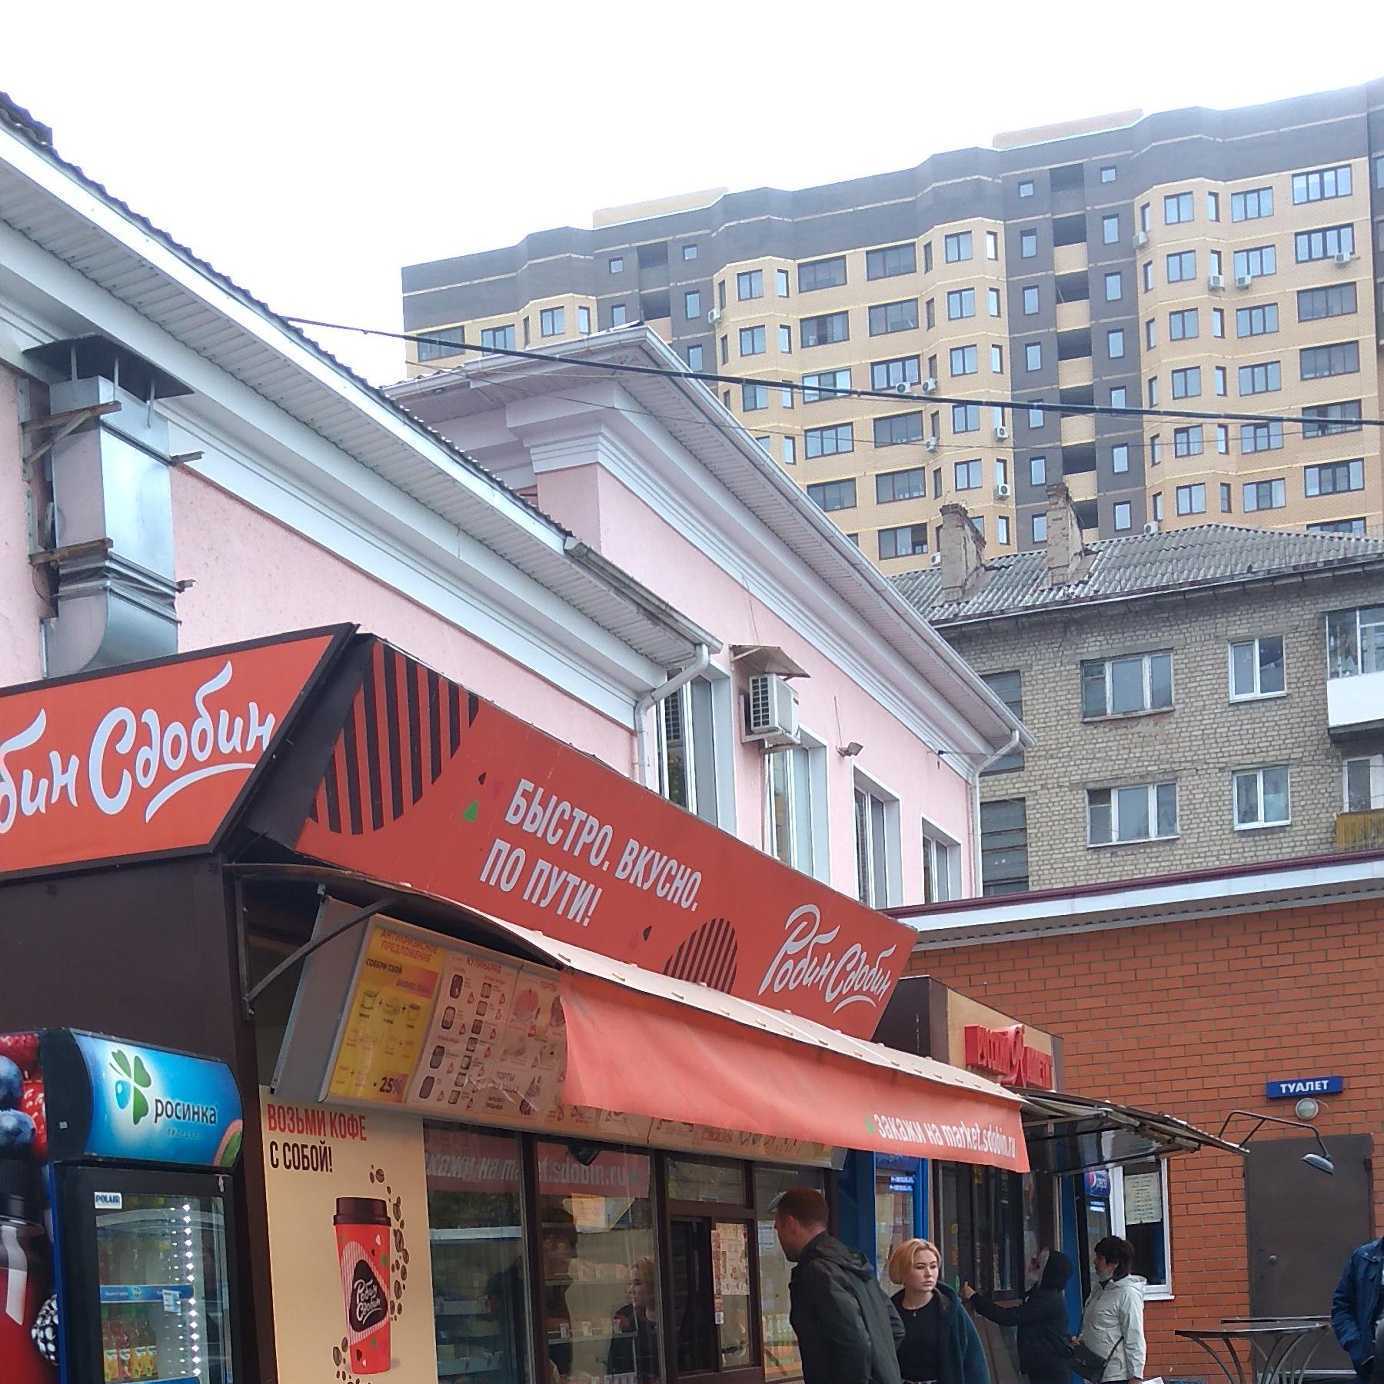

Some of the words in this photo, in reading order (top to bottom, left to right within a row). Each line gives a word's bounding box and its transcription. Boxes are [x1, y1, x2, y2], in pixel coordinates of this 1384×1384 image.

[88, 660, 275, 816] Сдобин
[504, 778, 614, 871] БЫСТРО.
[480, 838, 526, 892] ПО
[522, 858, 603, 926] ПУТИ!
[758, 904, 841, 996] Робин
[825, 943, 897, 1003] Сдобин
[1280, 1080, 1329, 1094] ТУАЛЕТ
[154, 1098, 217, 1125] росинка
[267, 1103, 326, 1137] ВОЗЬМИ
[329, 1111, 367, 1141] КОФЕ
[874, 1114, 926, 1144] закажи
[924, 1121, 944, 1146] на
[269, 1140, 280, 1168] С
[282, 1139, 333, 1173] СОБОЙ!
